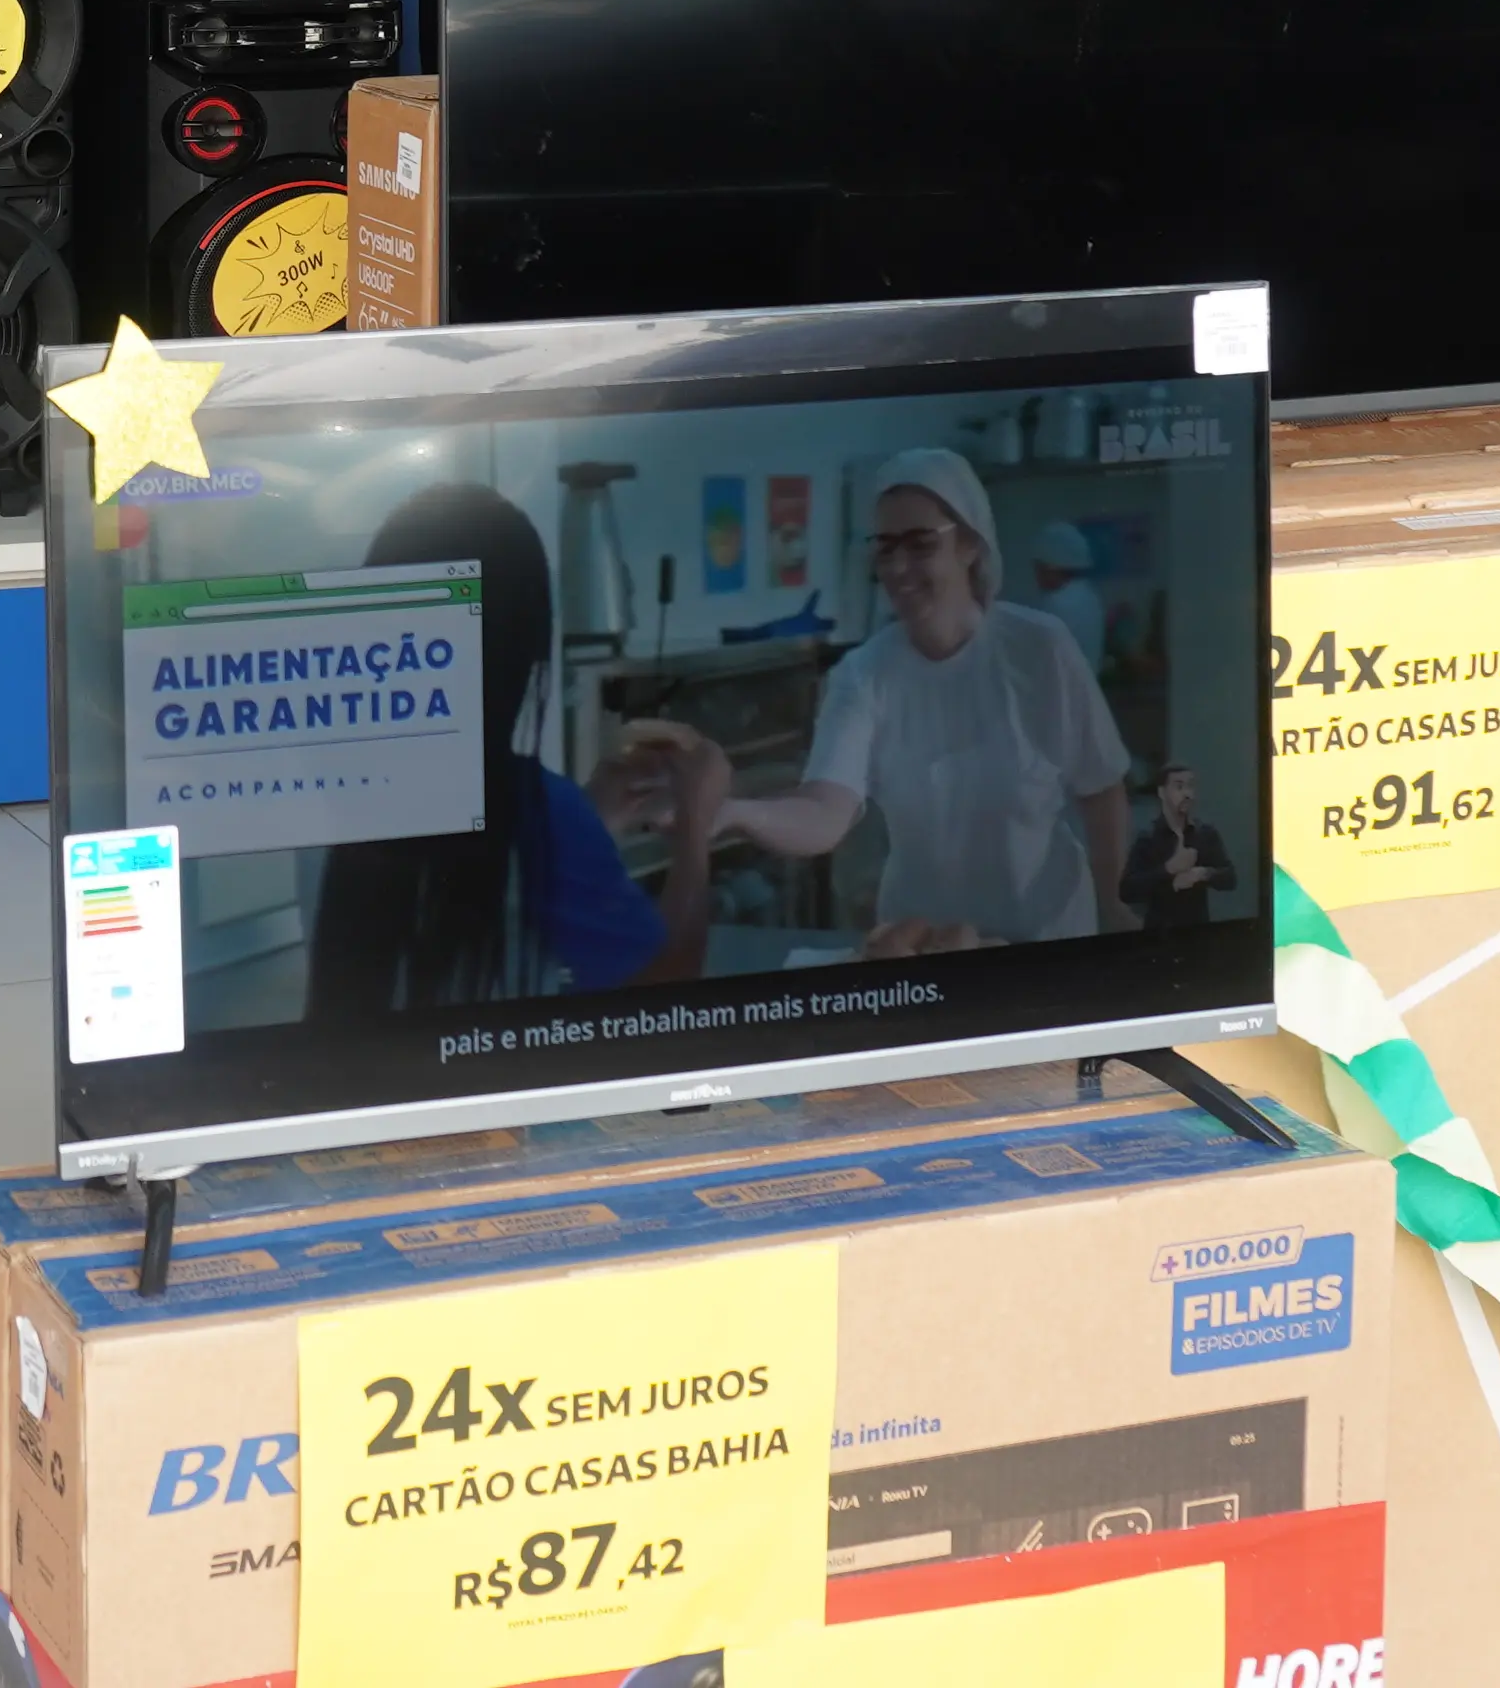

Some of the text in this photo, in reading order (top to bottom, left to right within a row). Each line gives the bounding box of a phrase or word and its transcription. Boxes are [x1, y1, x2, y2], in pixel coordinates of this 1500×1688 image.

[276, 250, 326, 288] 300W
[358, 226, 415, 264] Crystal UHD
[358, 265, 396, 295] U8600F
[151, 632, 454, 693] ALIMENTAÇÃO
[153, 685, 452, 741] GARANTIDA
[438, 979, 946, 1064] pais e mães trabalham mais tranquilos.
[1182, 1274, 1342, 1332] FILMES
[363, 1364, 769, 1458] 24x SEM JUROS
[857, 1414, 942, 1446] infinita
[344, 1428, 790, 1528] CARTÃO CASAS BAHIA
